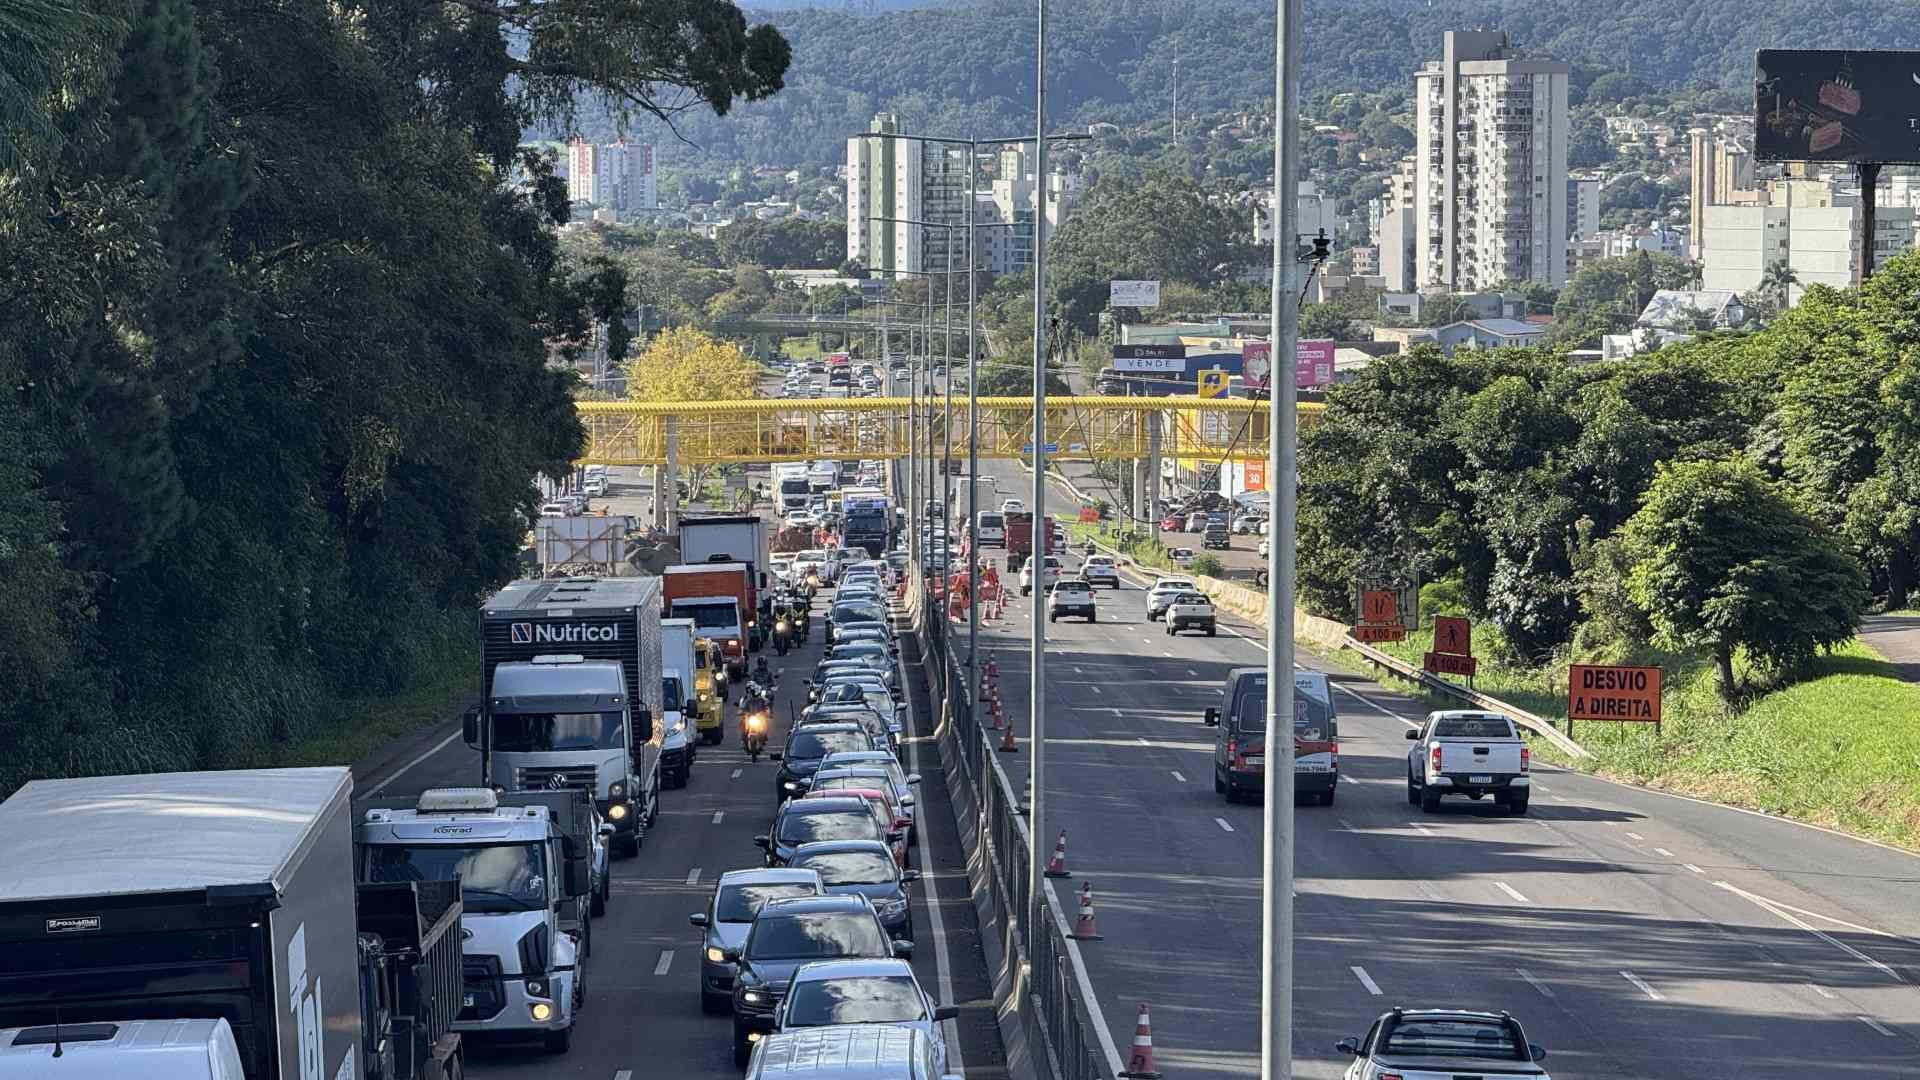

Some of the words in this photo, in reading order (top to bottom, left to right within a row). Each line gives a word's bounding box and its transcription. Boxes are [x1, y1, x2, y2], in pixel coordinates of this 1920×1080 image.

[1128, 359, 1171, 368] VENDE
[536, 623, 618, 642] Nutricol
[1362, 629, 1370, 639] A
[1371, 629, 1390, 639] 100
[1391, 630, 1401, 639] m
[1429, 660, 1437, 672] A
[1440, 660, 1458, 671] 100
[1583, 669, 1647, 691] DESVIO
[1574, 697, 1585, 714] A
[1590, 697, 1652, 717] DIREITA
[432, 826, 473, 834] Konrad
